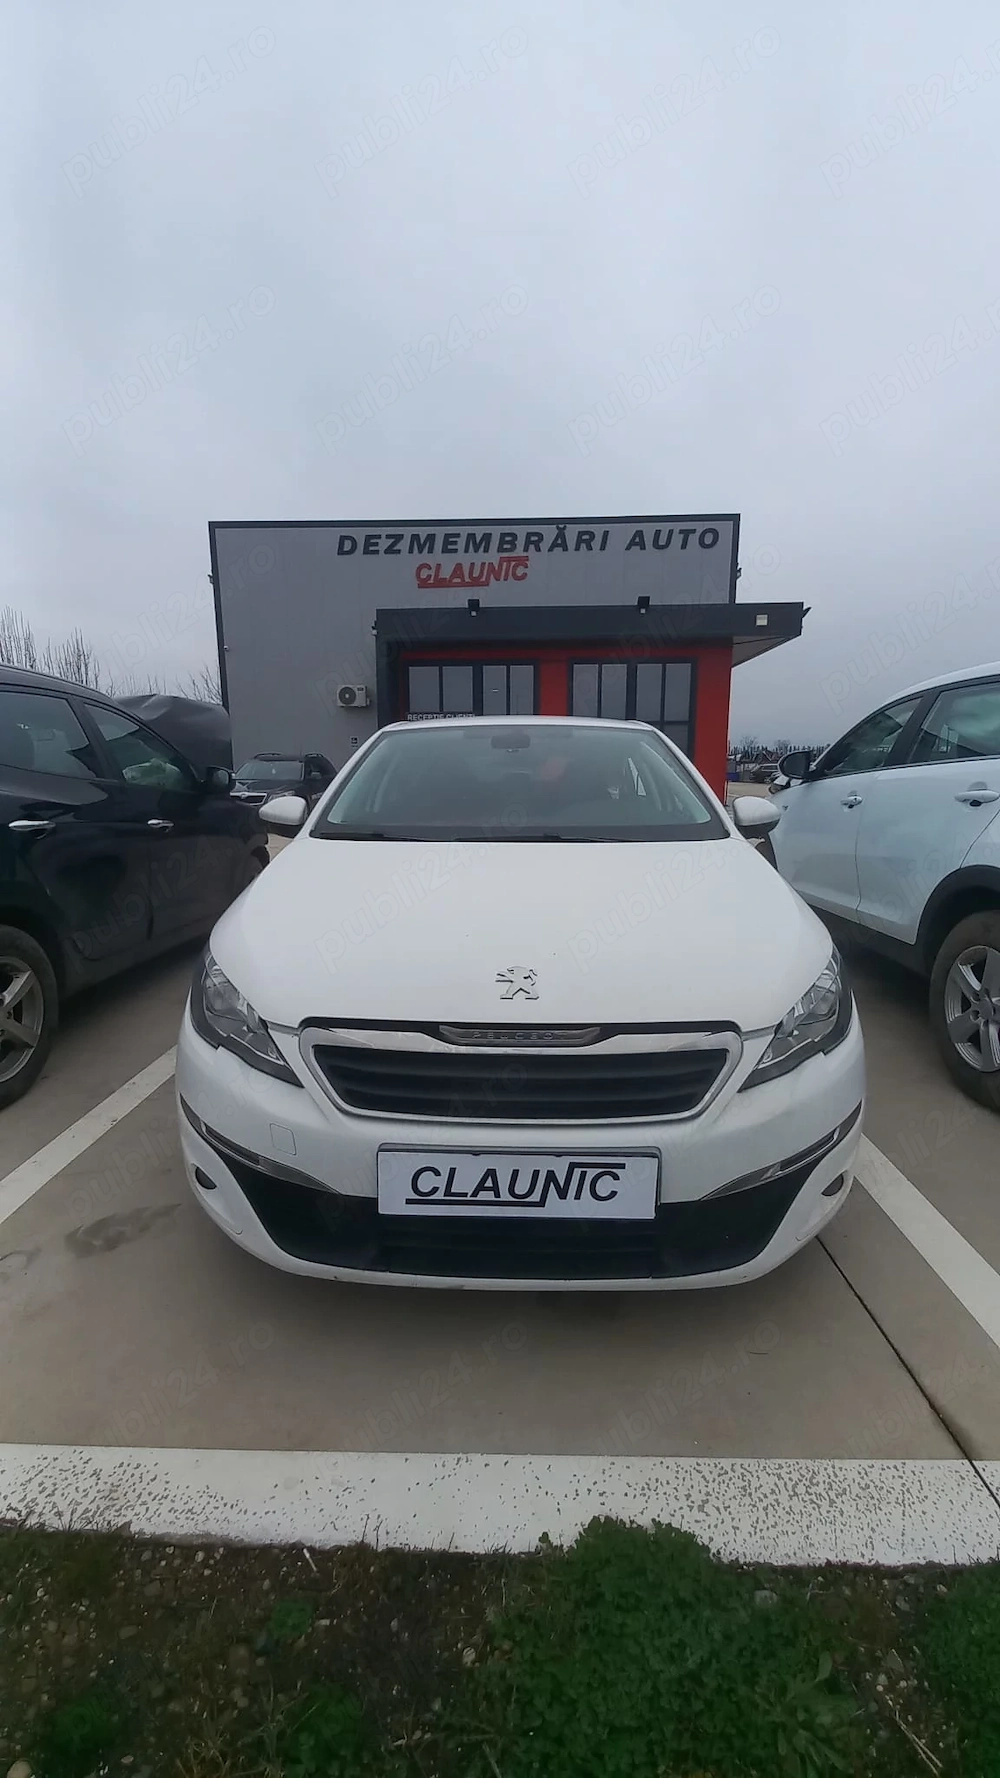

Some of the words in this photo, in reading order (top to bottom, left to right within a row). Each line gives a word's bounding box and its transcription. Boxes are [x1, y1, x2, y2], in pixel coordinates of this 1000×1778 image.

[337, 524, 610, 556] DEZMEMBRĂRI
[625, 527, 720, 552] AUTO
[415, 556, 529, 589] CLAUNIC
[405, 1162, 626, 1207] CLAUNIC
